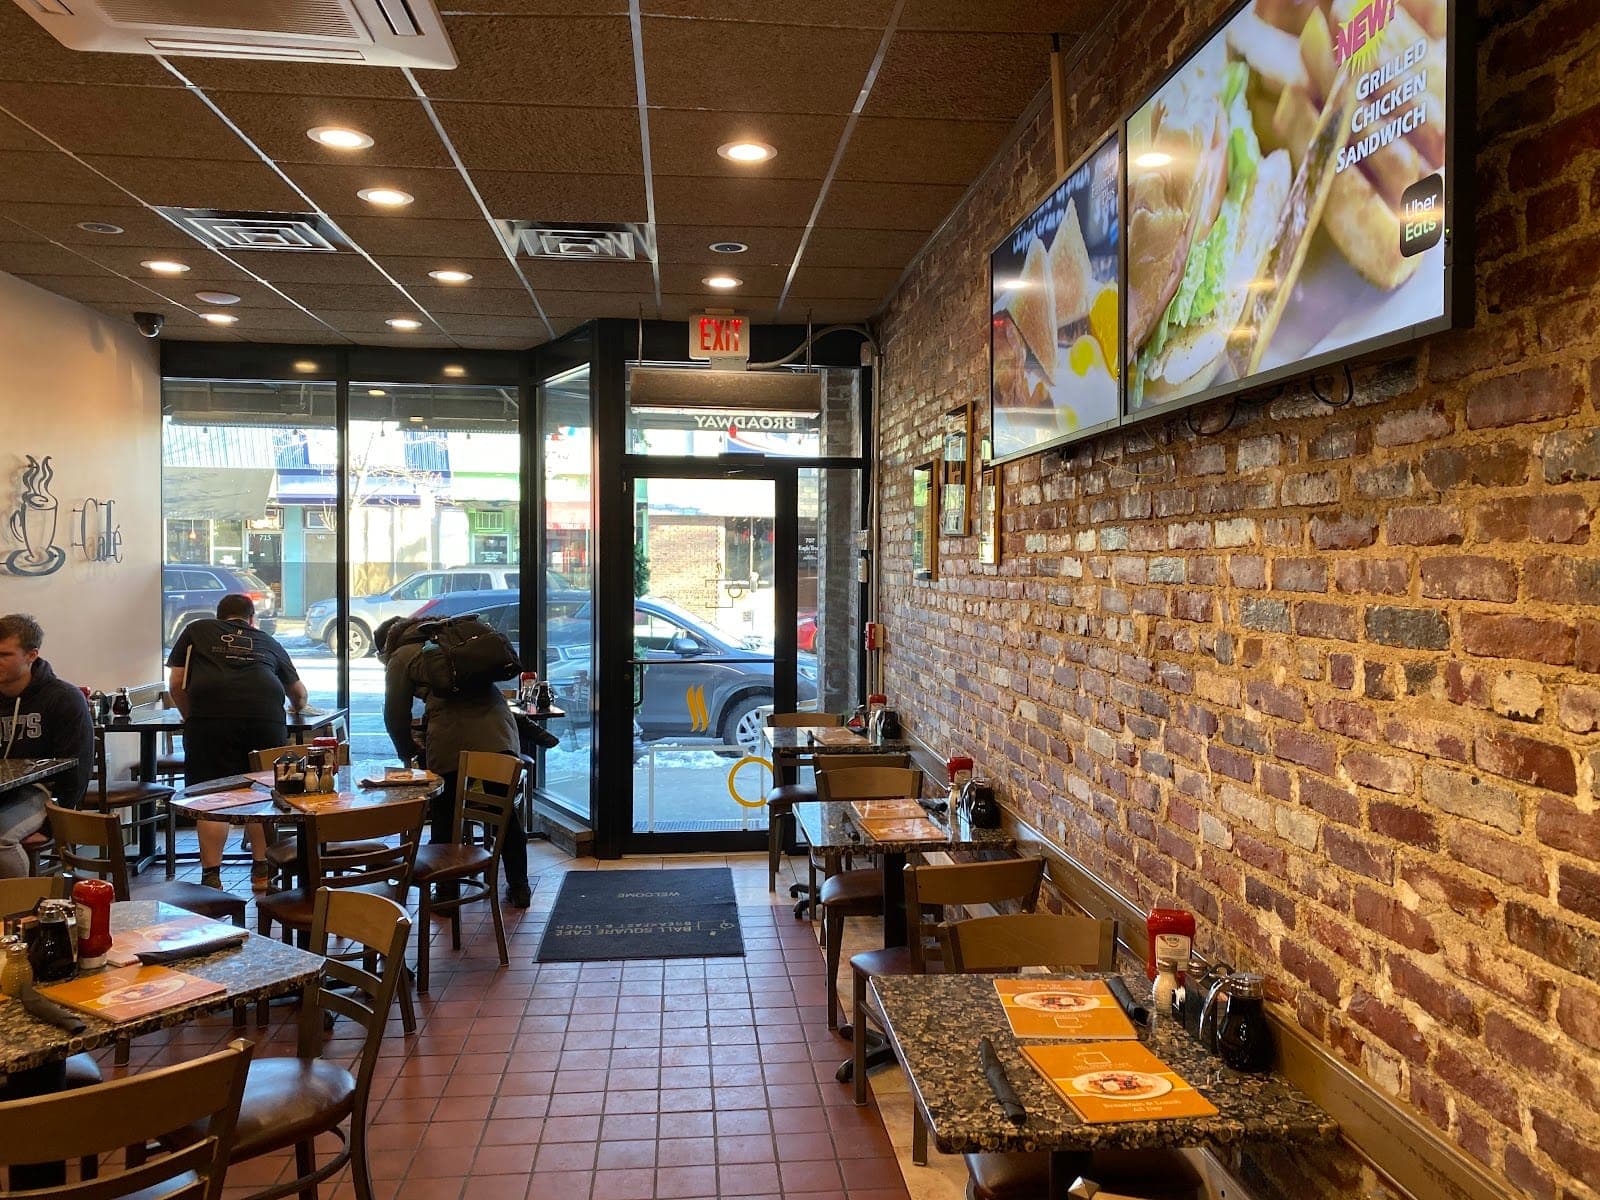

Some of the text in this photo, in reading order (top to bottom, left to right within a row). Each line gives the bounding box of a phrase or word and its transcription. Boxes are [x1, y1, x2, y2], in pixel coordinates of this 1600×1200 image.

[1355, 38, 1427, 100] GRILLED
[1350, 69, 1427, 133] CHICKEN
[1335, 101, 1427, 174] SANDWICH
[1405, 193, 1437, 218] Uber
[1405, 218, 1437, 242] Eats
[699, 317, 742, 351] EXIT
[81, 497, 123, 563] Café
[597, 927, 653, 935] SQUARE
